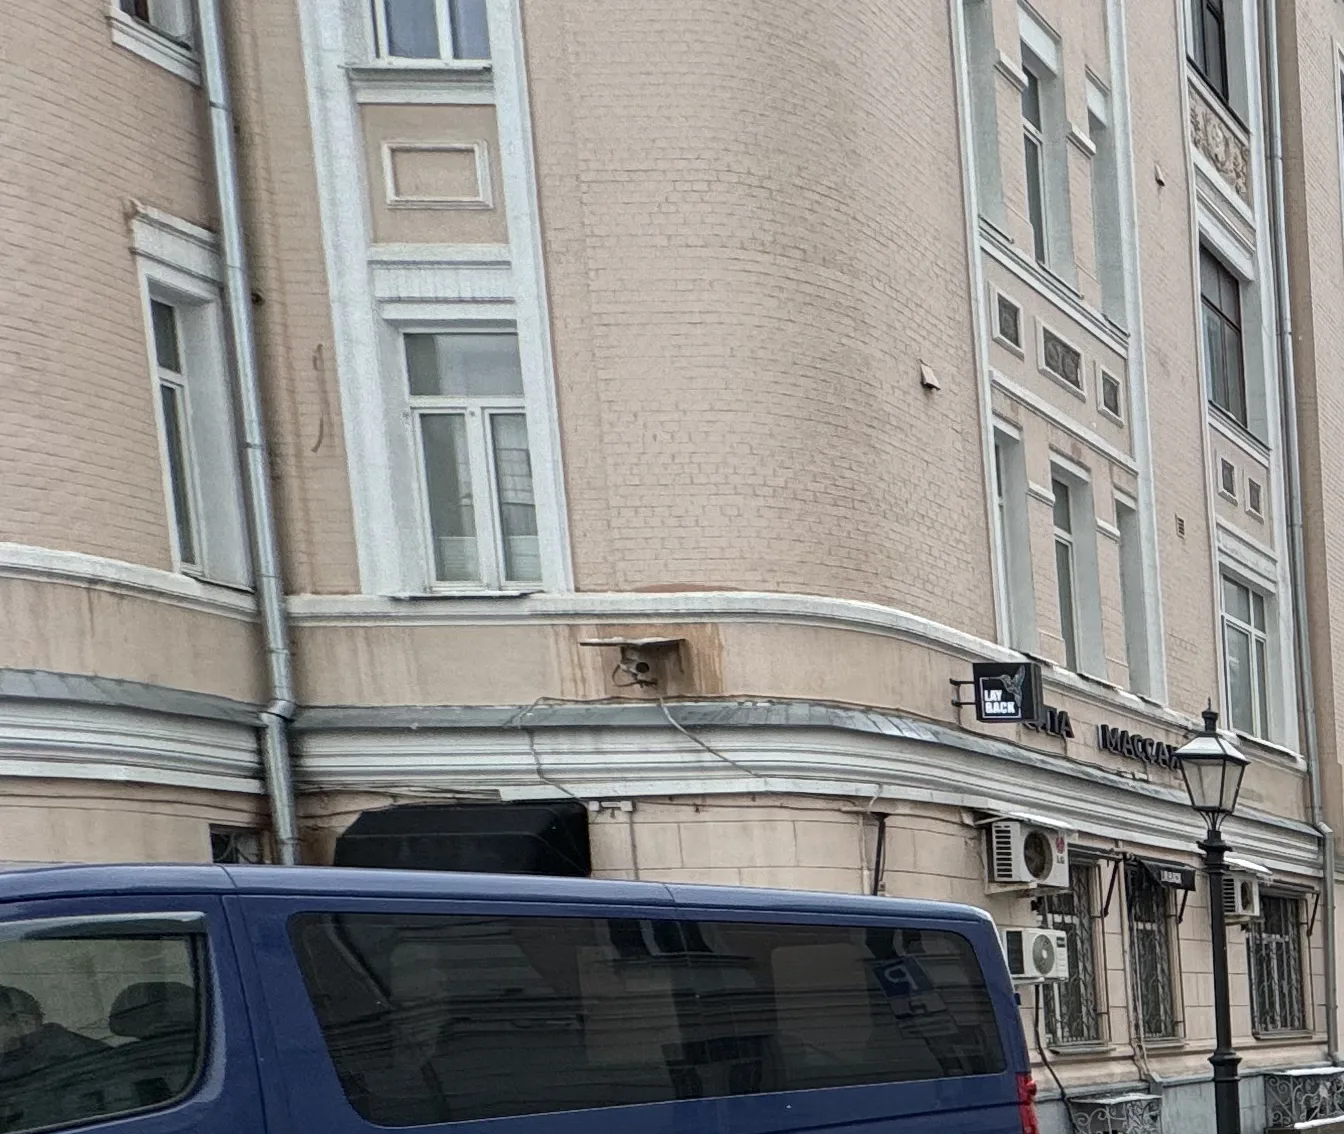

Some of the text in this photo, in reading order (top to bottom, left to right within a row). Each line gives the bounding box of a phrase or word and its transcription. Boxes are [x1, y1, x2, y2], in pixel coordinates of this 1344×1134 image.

[984, 689, 1002, 701] LAY
[985, 701, 1015, 713] BACK
[1056, 856, 1065, 864] LG
